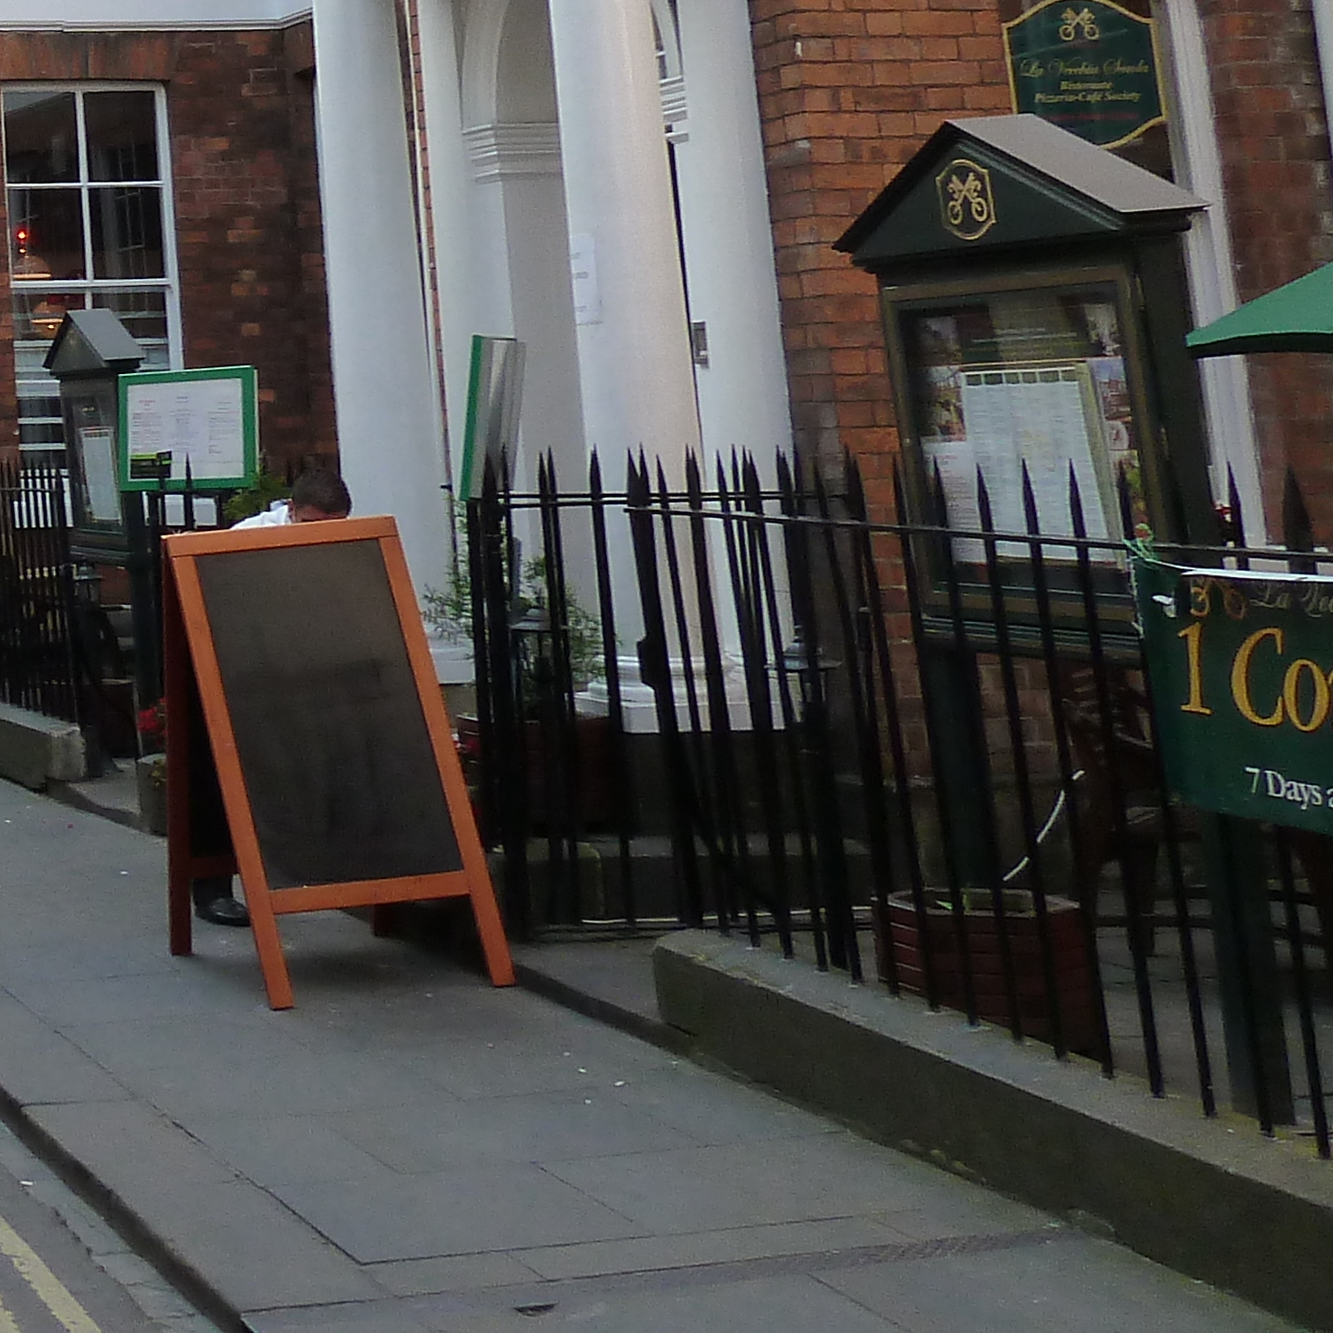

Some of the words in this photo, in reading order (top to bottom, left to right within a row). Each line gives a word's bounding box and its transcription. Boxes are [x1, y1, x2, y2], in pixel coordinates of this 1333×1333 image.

[1177, 621, 1212, 715] 1
[1230, 627, 1333, 733] Co
[1245, 766, 1260, 793] 7
[1264, 769, 1323, 811] Days
